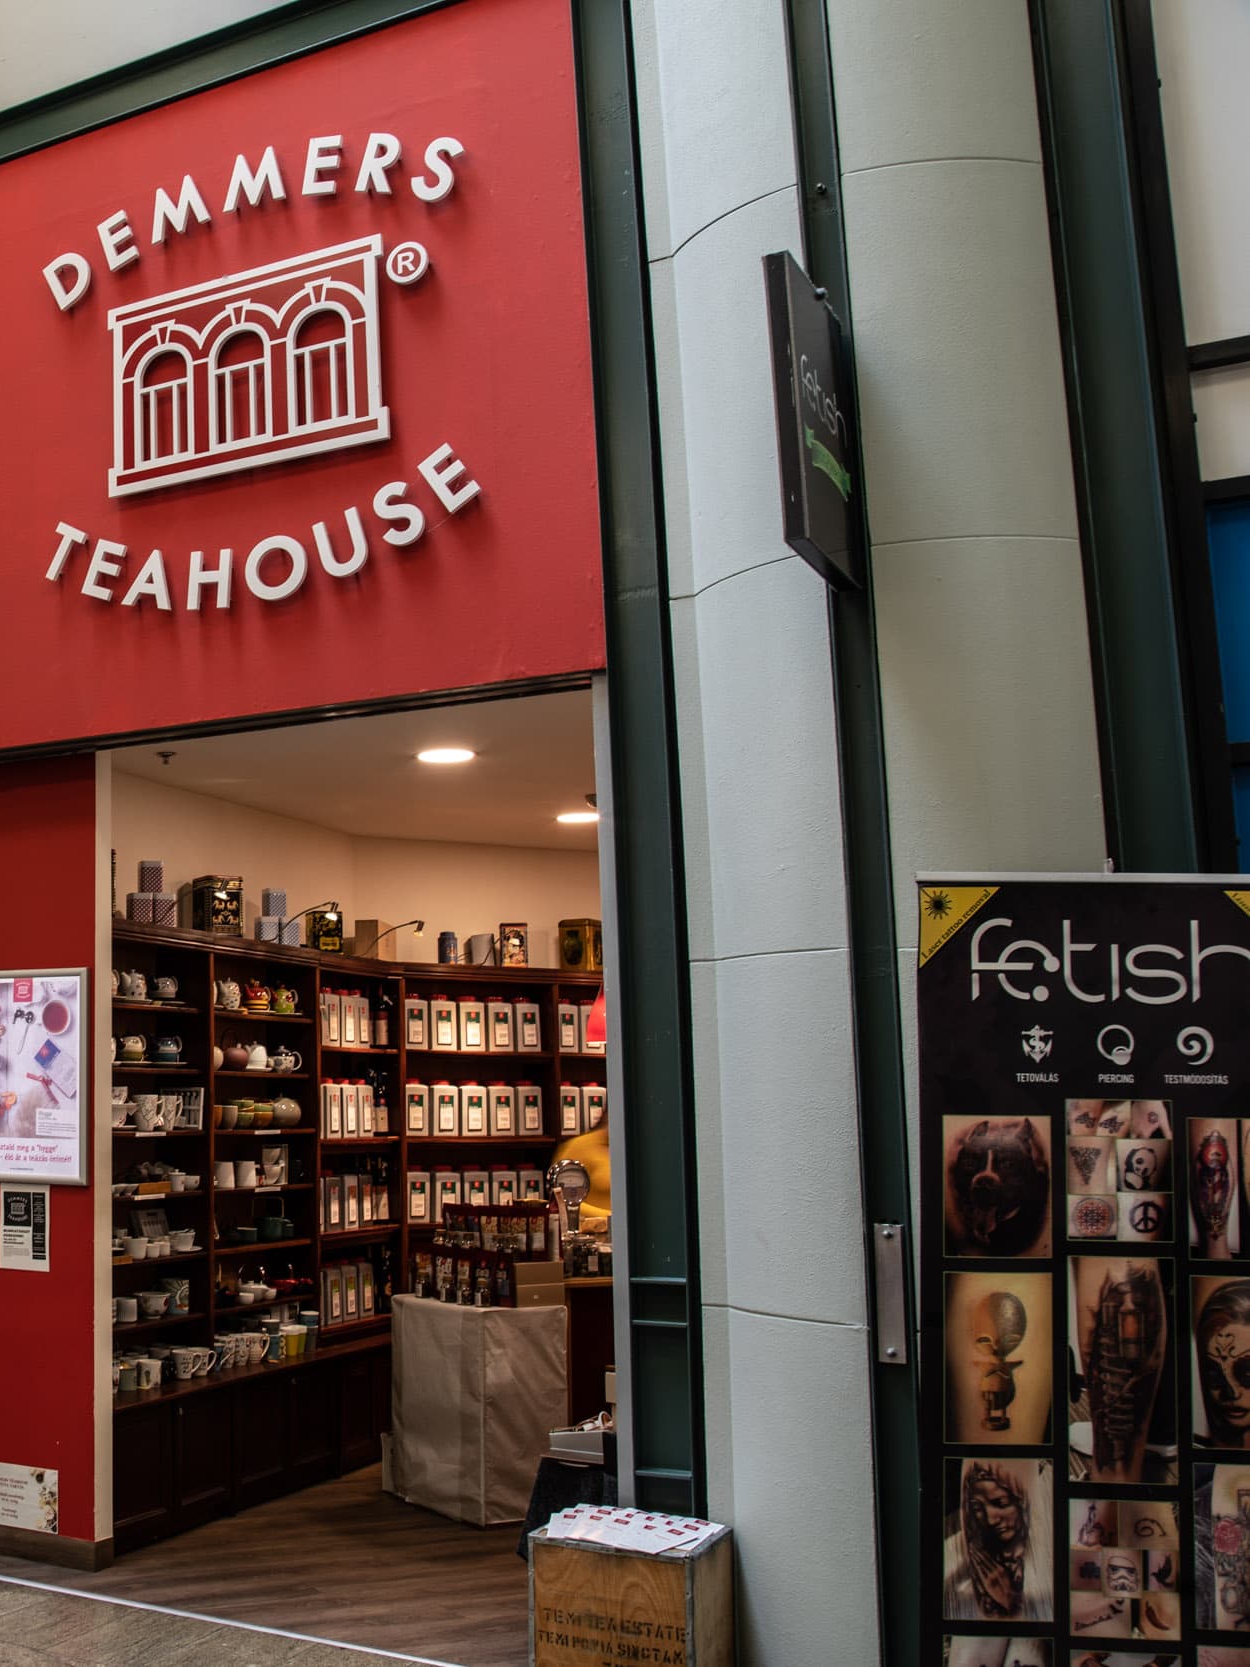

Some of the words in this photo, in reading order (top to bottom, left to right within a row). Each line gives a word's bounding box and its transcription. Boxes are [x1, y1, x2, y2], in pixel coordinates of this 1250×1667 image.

[42, 132, 465, 312] DEMMERS
[45, 442, 482, 612] TEAHOUSE
[921, 938, 942, 960] Laser
[941, 918, 964, 940] tattoo
[962, 888, 991, 920] removal
[970, 917, 1250, 1005] fetish
[1015, 1071, 1059, 1083] TETOVÁLÁS
[1098, 1073, 1135, 1084] PIERCING
[1164, 1073, 1229, 1085] TESTMÓDOSÍTÁS
